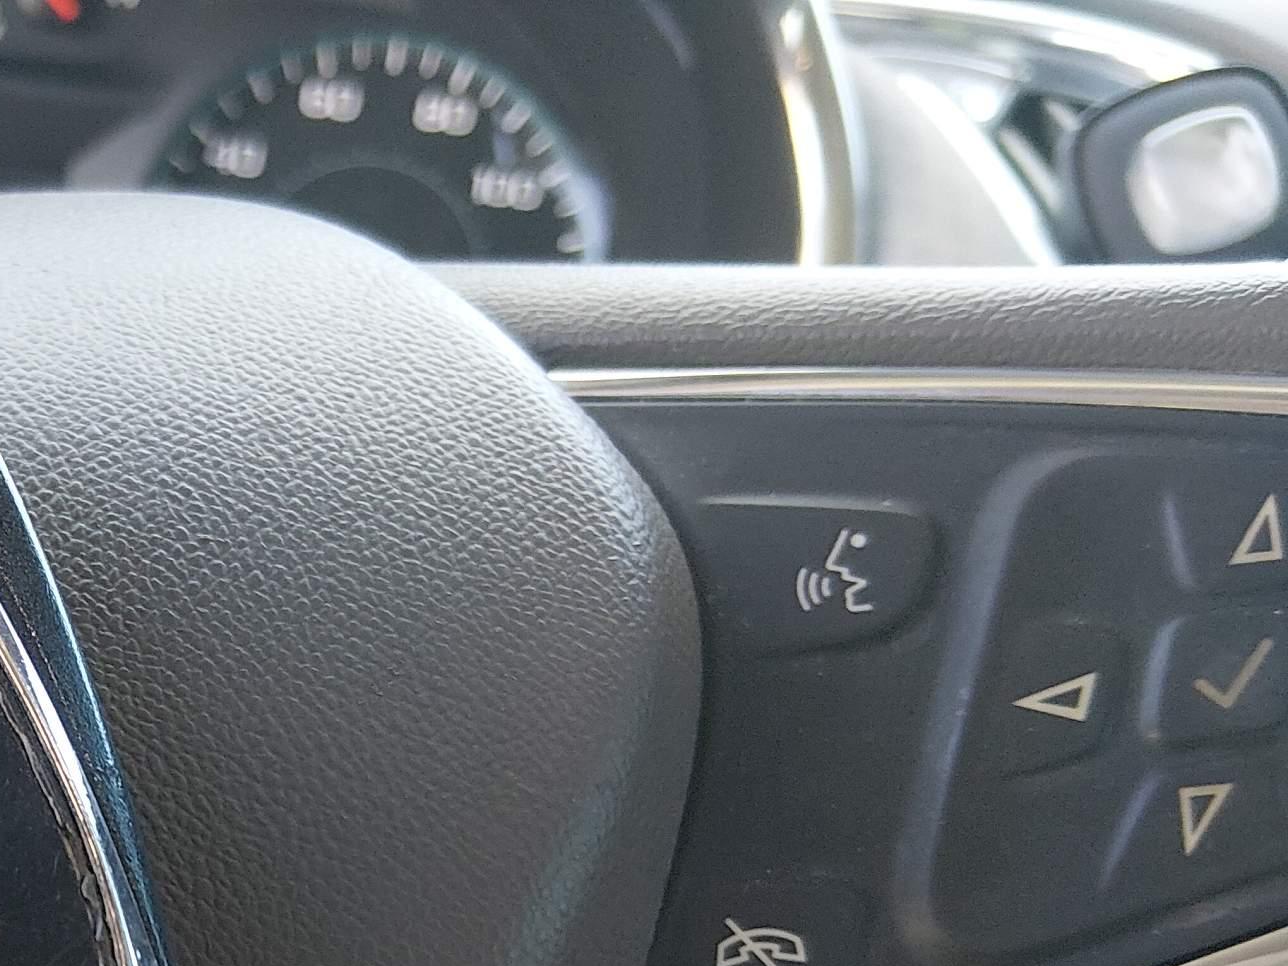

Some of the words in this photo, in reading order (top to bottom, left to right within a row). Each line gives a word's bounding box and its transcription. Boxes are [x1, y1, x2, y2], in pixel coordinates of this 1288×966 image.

[299, 77, 365, 122] 60
[412, 86, 479, 136] 80
[470, 165, 544, 212] 100
